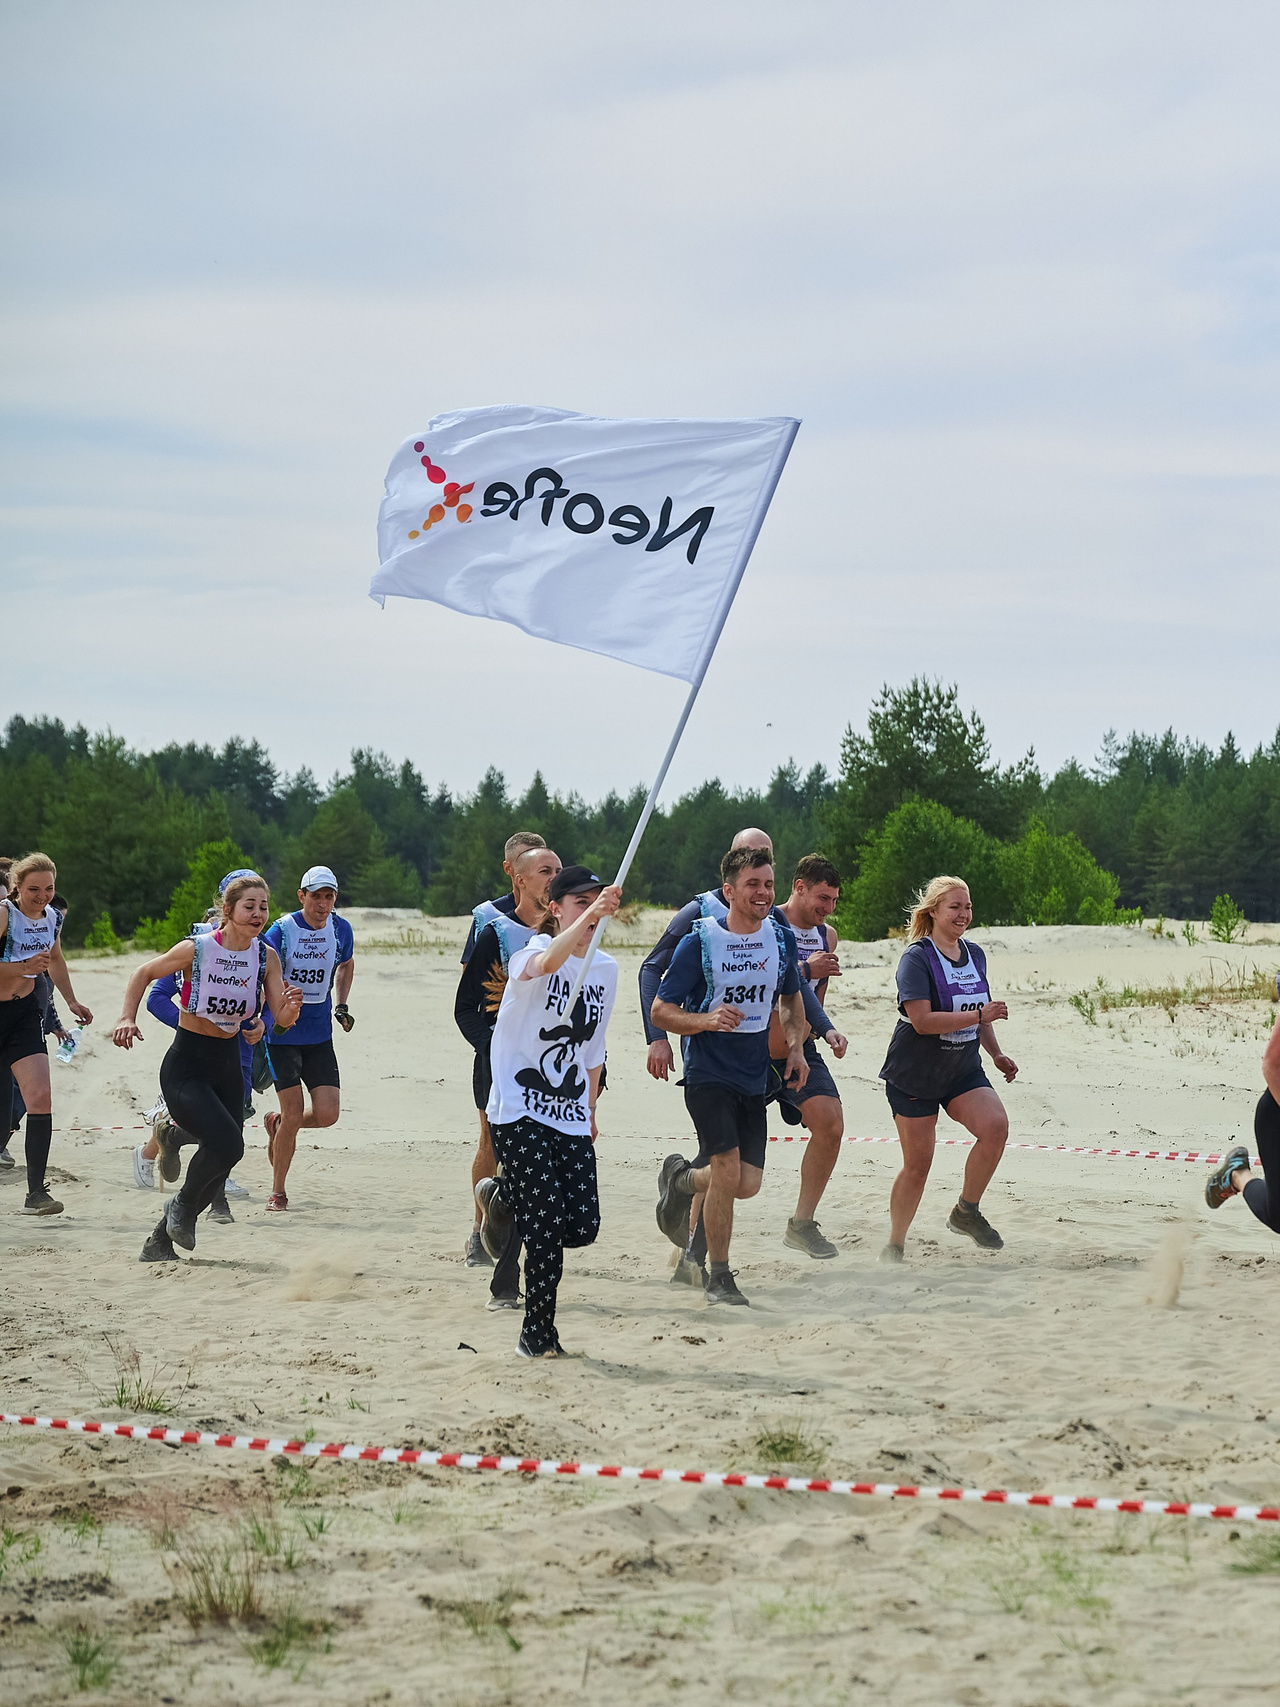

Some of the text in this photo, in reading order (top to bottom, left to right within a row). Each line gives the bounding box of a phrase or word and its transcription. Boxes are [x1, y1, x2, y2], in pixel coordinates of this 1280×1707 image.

[290, 968, 325, 984] 5339
[723, 984, 766, 1004] 5341
[206, 996, 247, 1017] 5334
